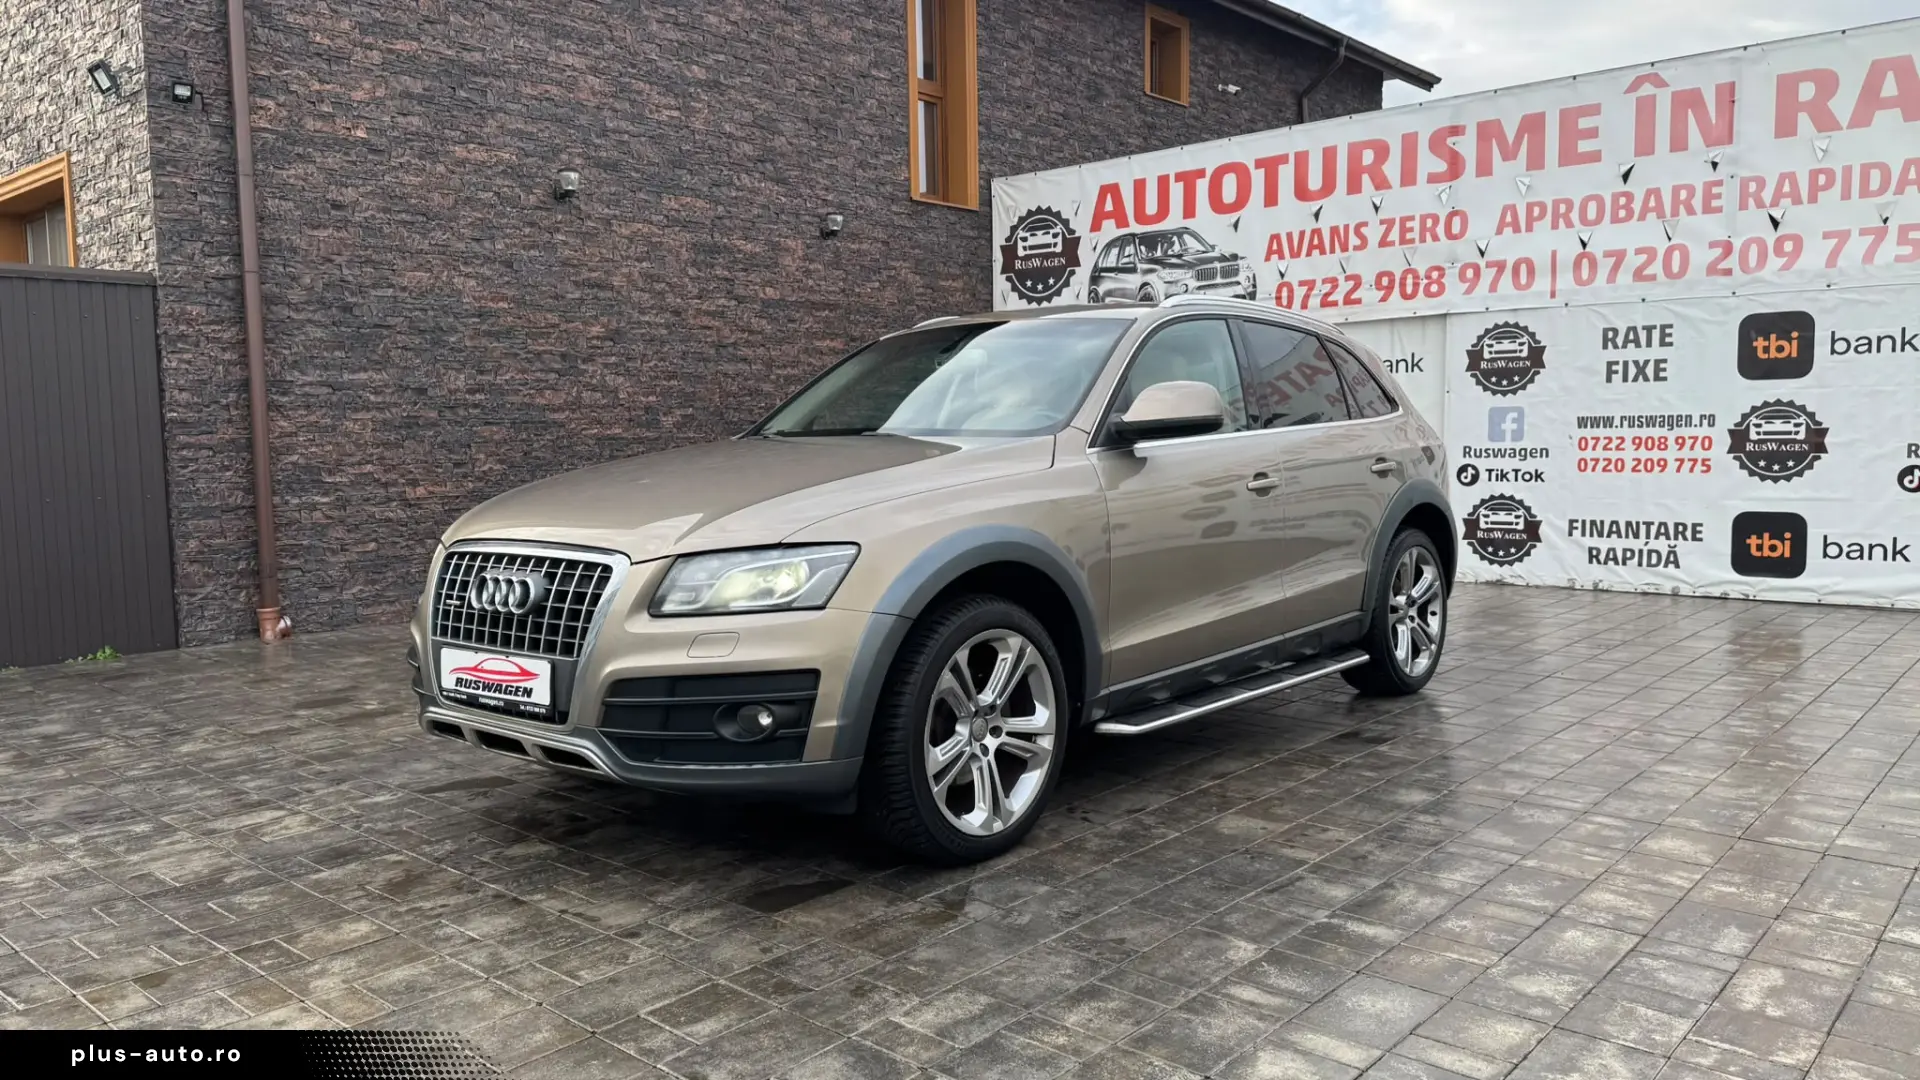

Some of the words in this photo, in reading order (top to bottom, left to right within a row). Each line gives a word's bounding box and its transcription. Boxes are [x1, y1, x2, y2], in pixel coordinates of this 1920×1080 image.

[1089, 103, 1602, 233] AUTOTURISME
[1623, 72, 1736, 158] ÎN
[1264, 221, 1369, 263] AVANS
[1378, 210, 1469, 248] ZERO
[1495, 179, 1724, 236] APROBARE
[1738, 157, 1920, 211] RAPIDA
[1275, 274, 1363, 311] 0722
[1375, 265, 1447, 303] 908
[1458, 257, 1536, 296] 970
[1573, 243, 1690, 287] 0720
[1706, 233, 1804, 277] 209
[1822, 223, 1920, 269] 775
[1602, 324, 1674, 350] RATE
[1753, 331, 1799, 359] tbi
[1830, 327, 1920, 356] bank
[1383, 352, 1424, 374] ank
[1606, 359, 1668, 384] FIXE
[1577, 414, 1716, 431] www.ruswagen.ro
[1463, 446, 1550, 461] Ruswagen
[1578, 436, 1626, 452] 0722
[1631, 436, 1669, 452] 908
[1674, 436, 1713, 452] 970
[1484, 468, 1546, 483] TikTok
[1577, 457, 1626, 473] 0720
[1631, 457, 1669, 473] 209
[1674, 457, 1712, 474] 775
[1745, 532, 1793, 558] tbi
[1822, 535, 1912, 563] bank
[455, 677, 533, 698] RUSWAGEN
